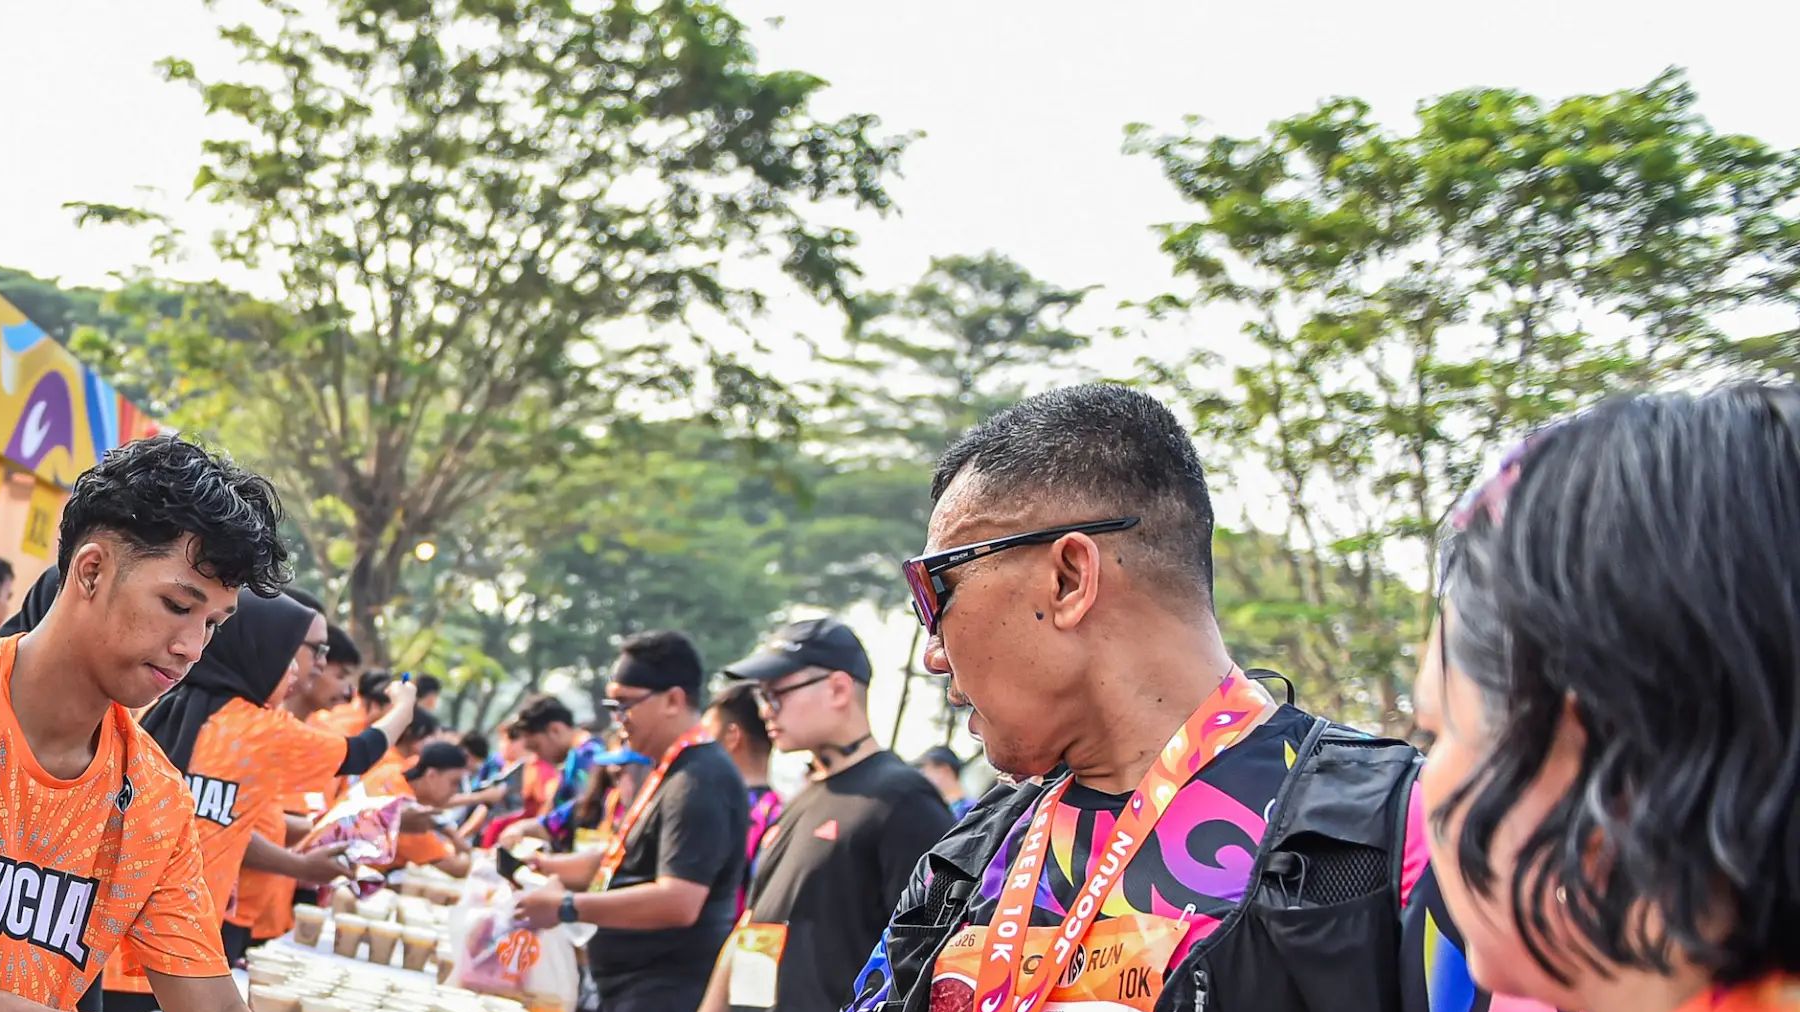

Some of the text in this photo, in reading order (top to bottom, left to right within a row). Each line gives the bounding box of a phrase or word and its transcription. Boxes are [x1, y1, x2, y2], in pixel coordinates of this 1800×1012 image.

[1053, 830, 1135, 965] JCORUN
[990, 904, 1024, 964] 10K
[1086, 943, 1124, 973] RUN
[1118, 966, 1153, 1000] 10K
